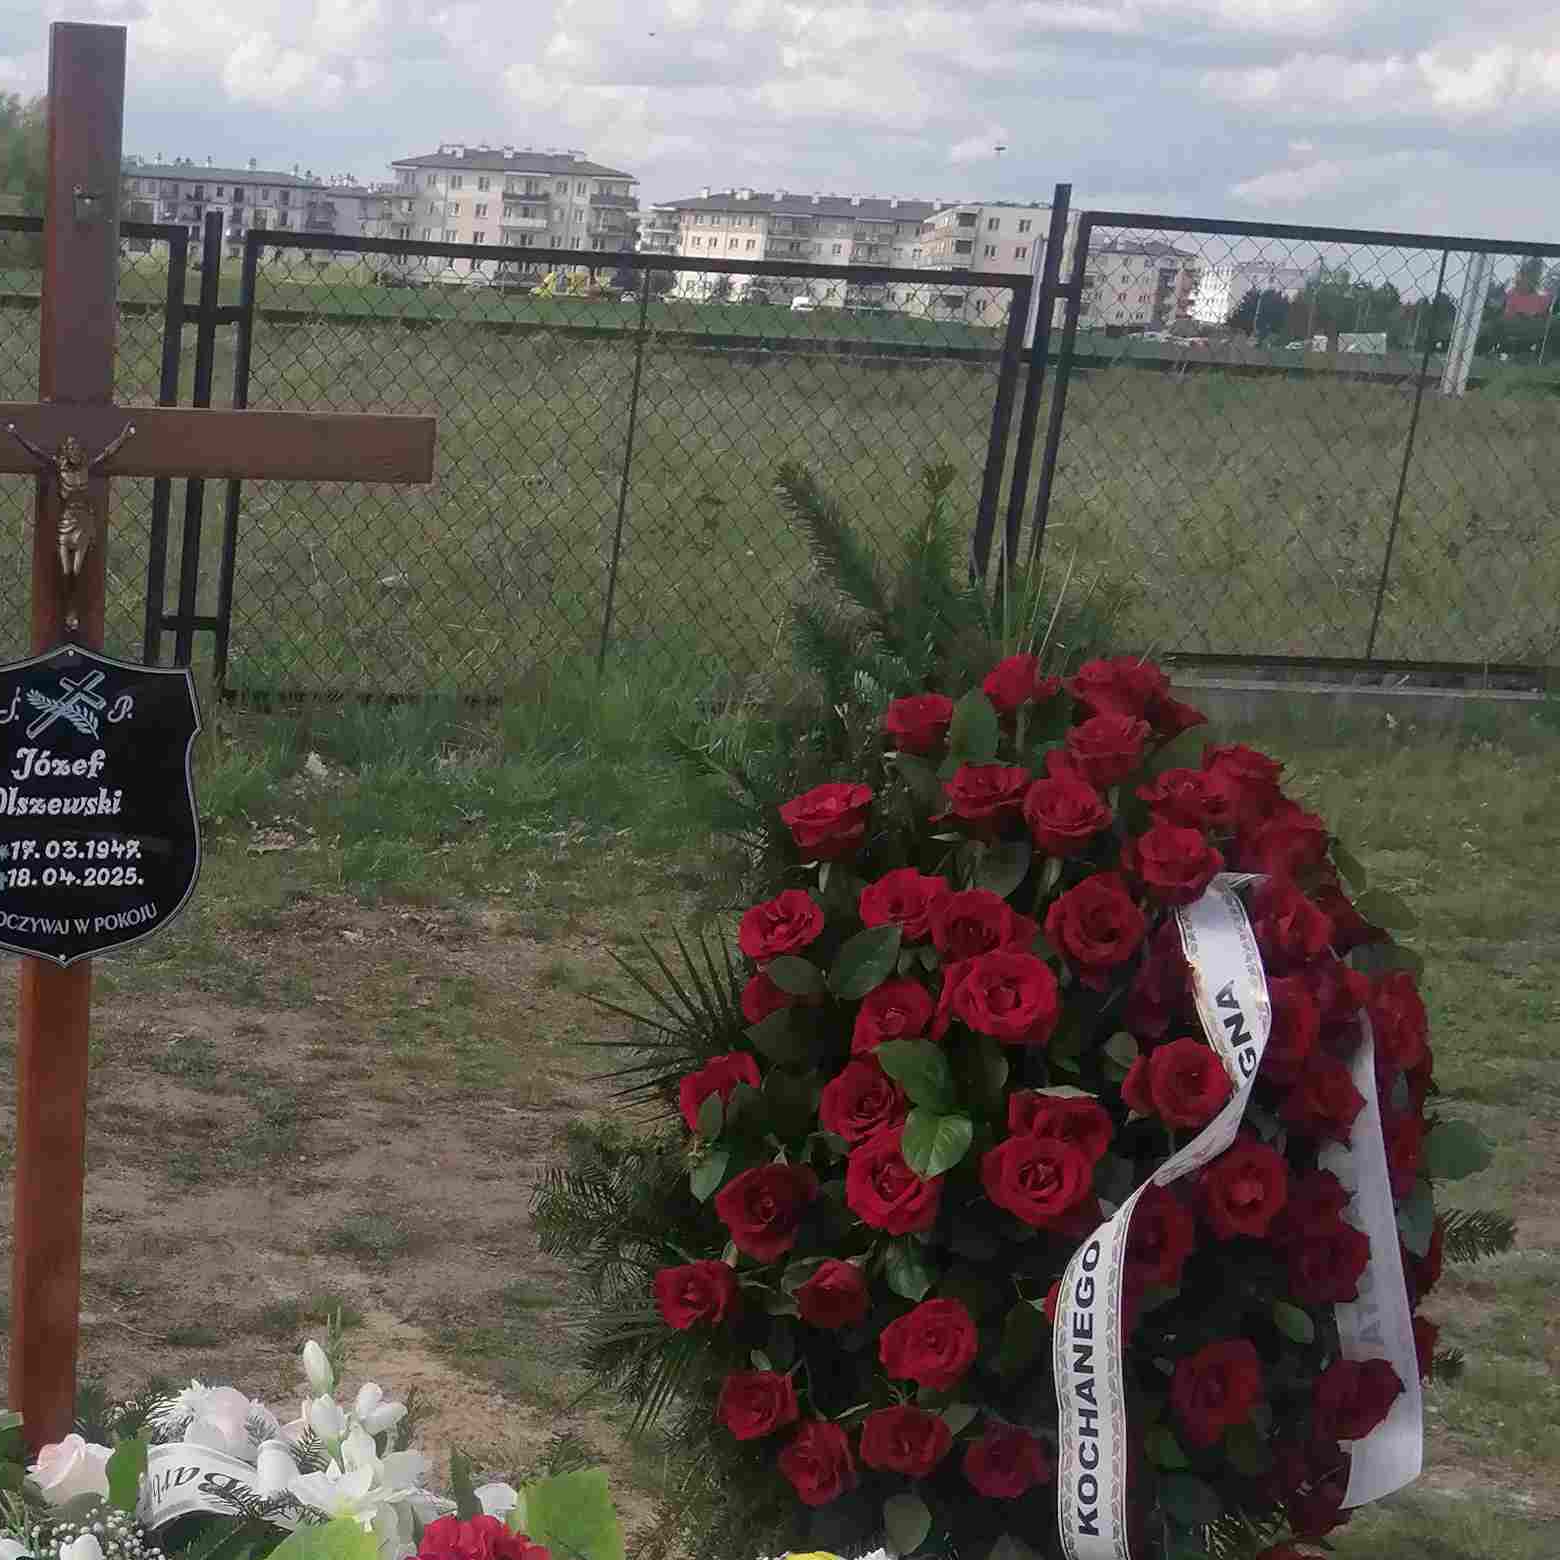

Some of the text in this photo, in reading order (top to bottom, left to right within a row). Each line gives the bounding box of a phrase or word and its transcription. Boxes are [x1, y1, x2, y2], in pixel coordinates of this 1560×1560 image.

[11, 748, 106, 780] Józef
[72, 917, 90, 935] W
[94, 901, 159, 932] POKOJU
[1072, 1238, 1102, 1537] KOCHANEGO
